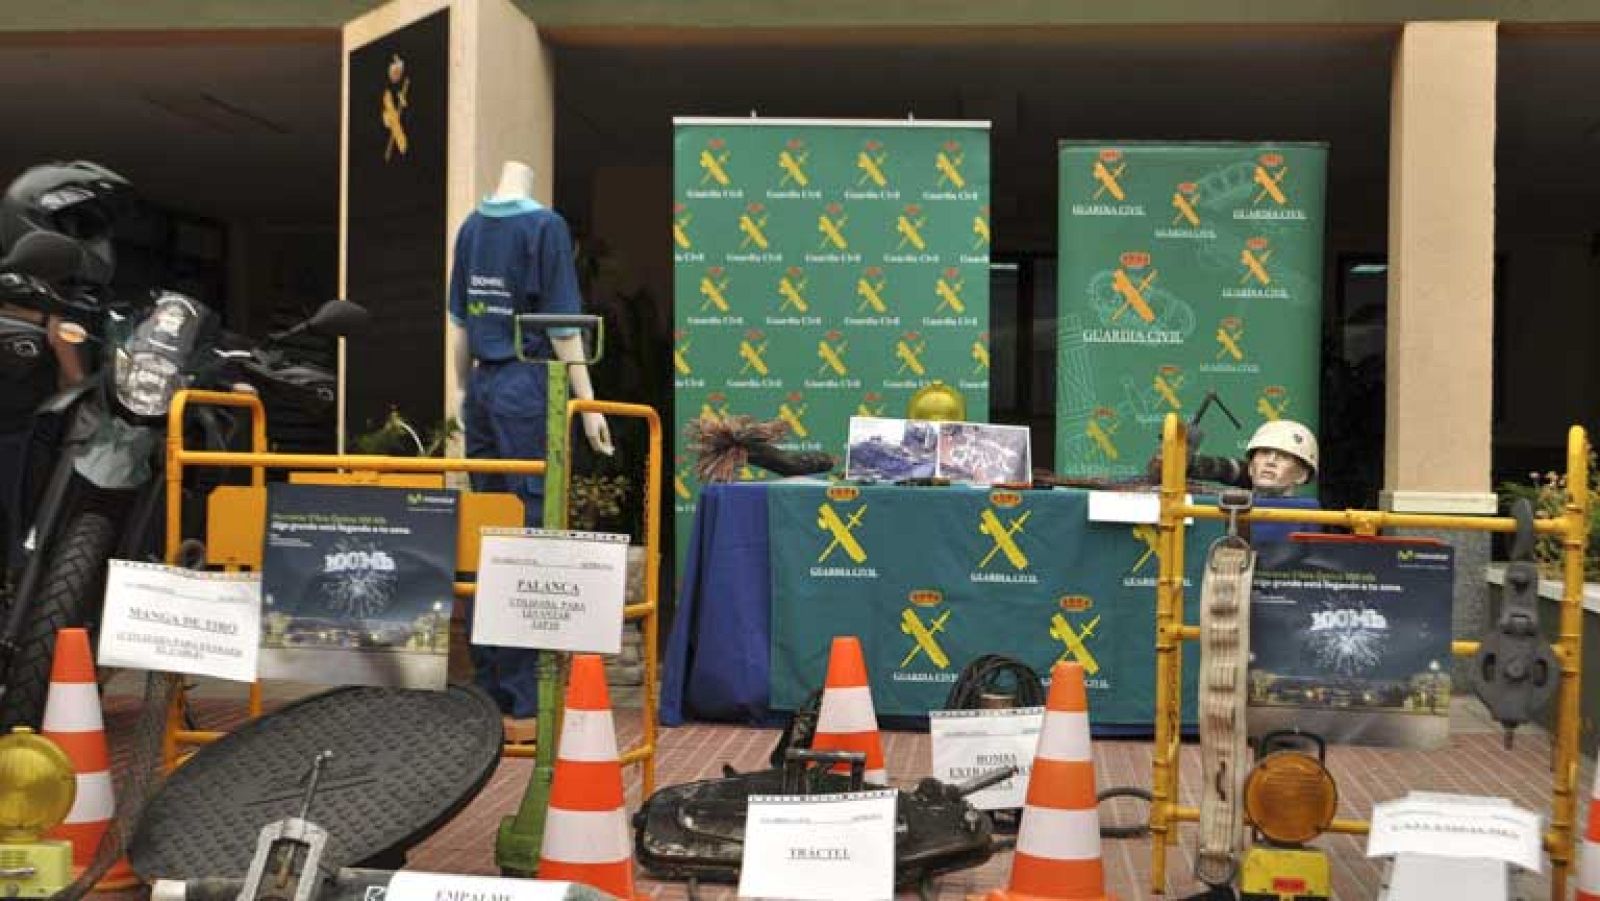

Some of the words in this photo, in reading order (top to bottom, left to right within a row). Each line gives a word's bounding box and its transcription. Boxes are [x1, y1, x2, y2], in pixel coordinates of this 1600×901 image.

[1083, 329, 1146, 343] GUARDIA
[1147, 331, 1184, 345] CIVIL
[517, 579, 580, 597] PALANCA
[129, 606, 180, 626] MANGA
[182, 616, 201, 629] DE
